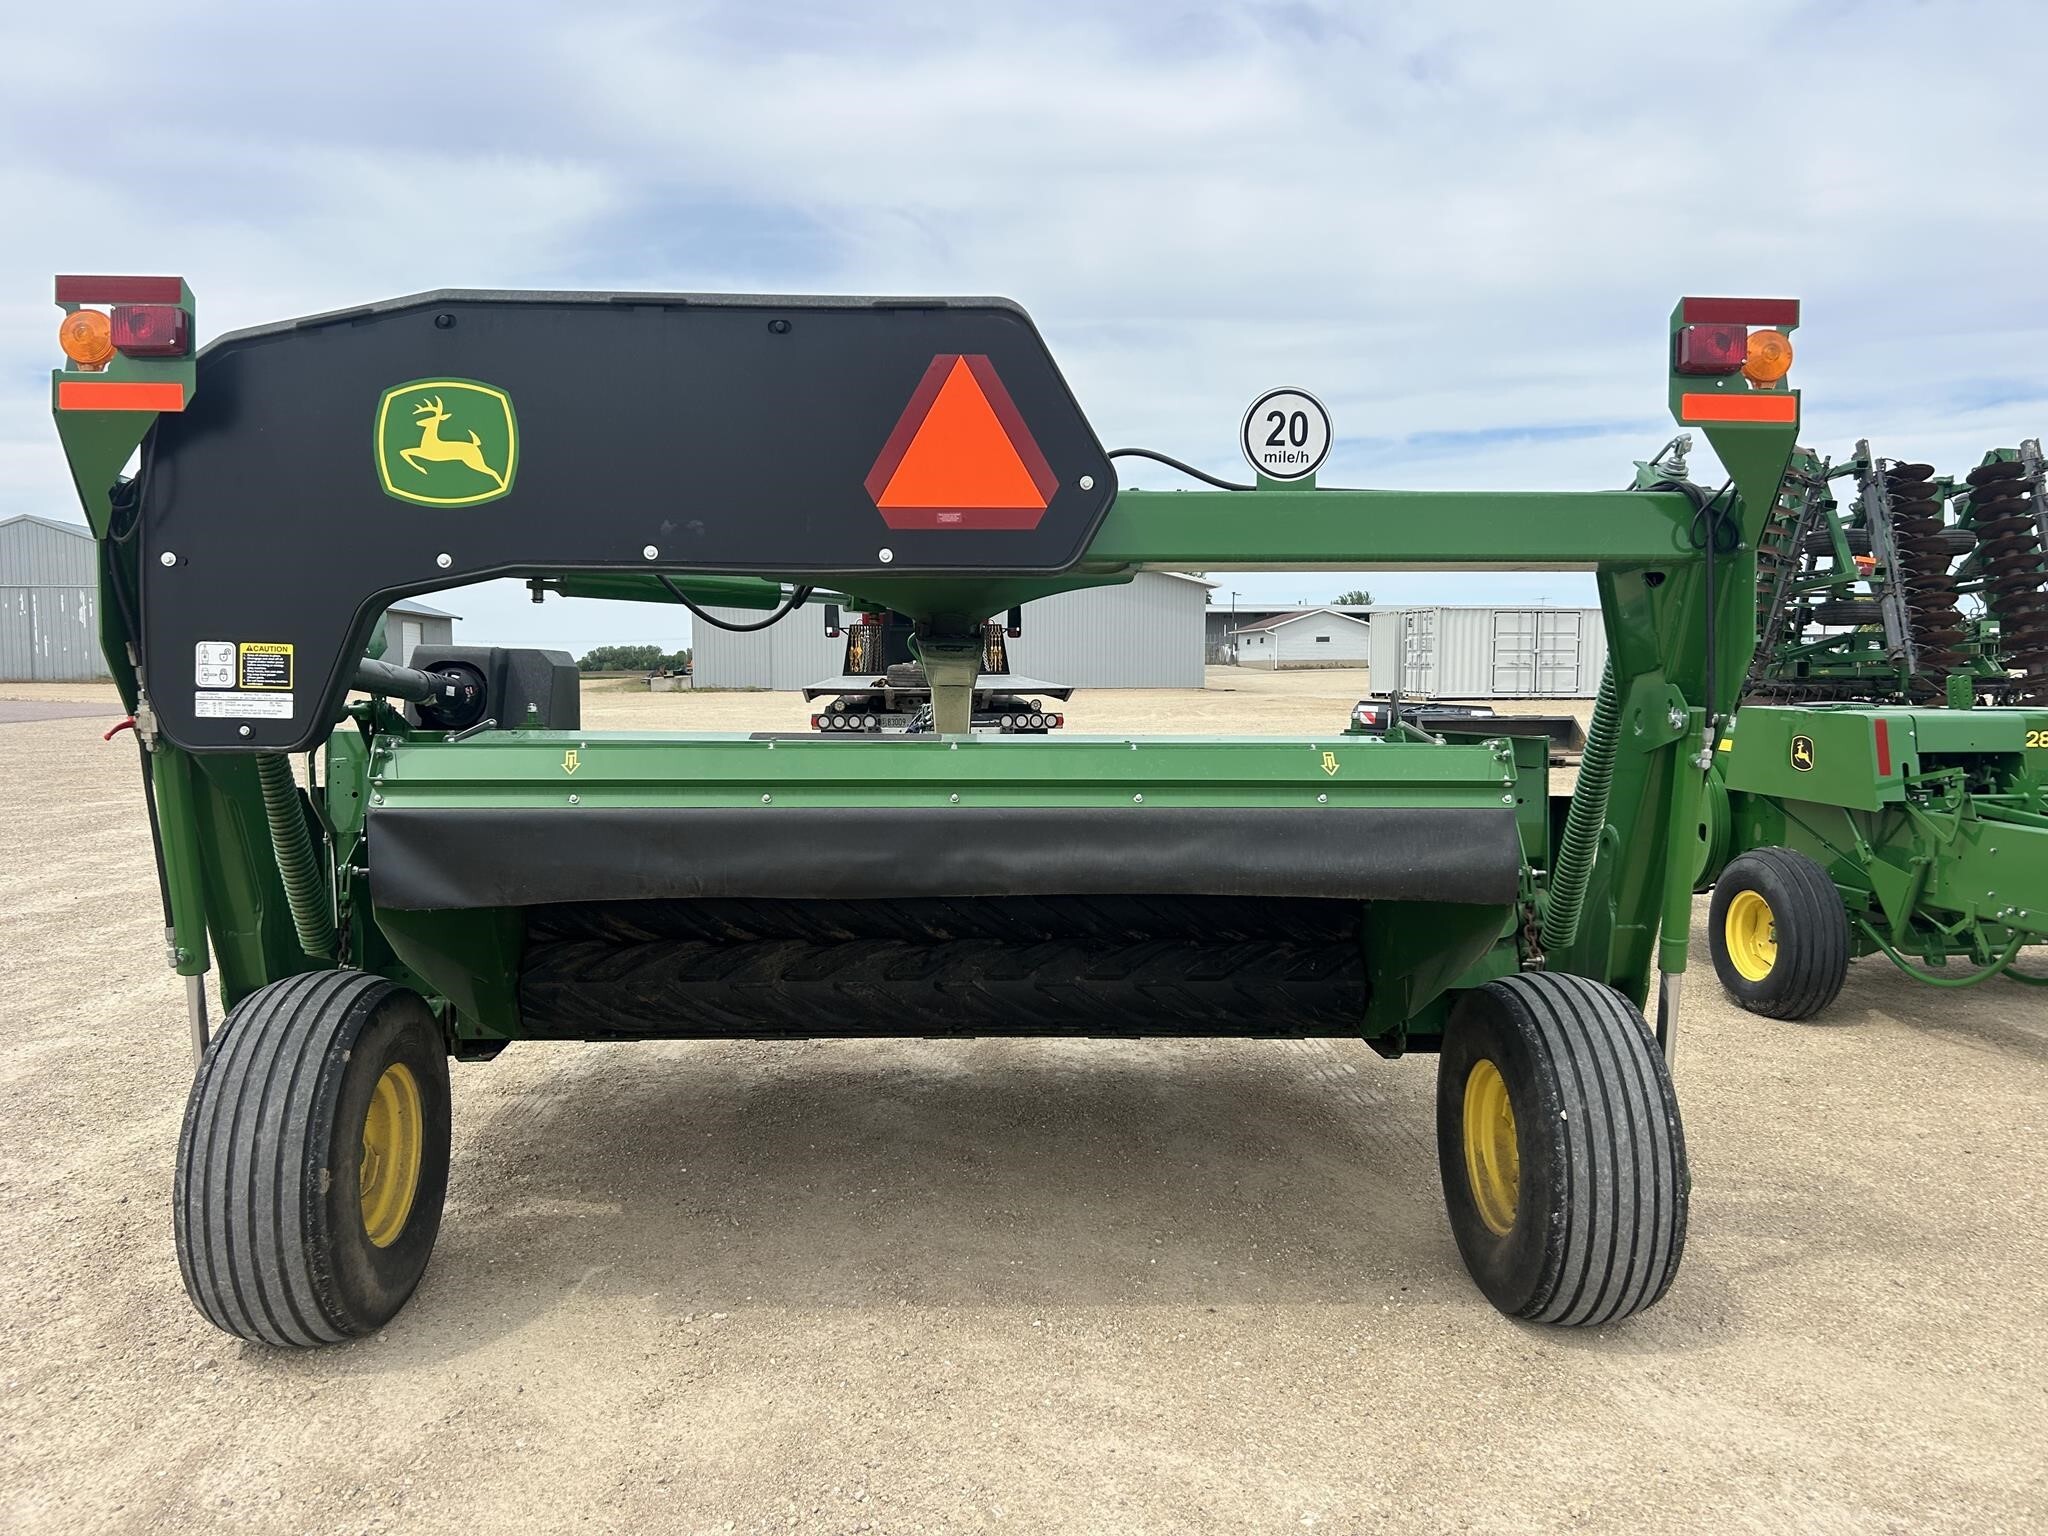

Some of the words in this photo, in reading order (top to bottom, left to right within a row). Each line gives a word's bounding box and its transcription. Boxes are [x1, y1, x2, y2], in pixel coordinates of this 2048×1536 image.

[1265, 410, 1309, 448] 20
[1264, 450, 1309, 463] mile/h
[253, 645, 289, 653] CAUTION
